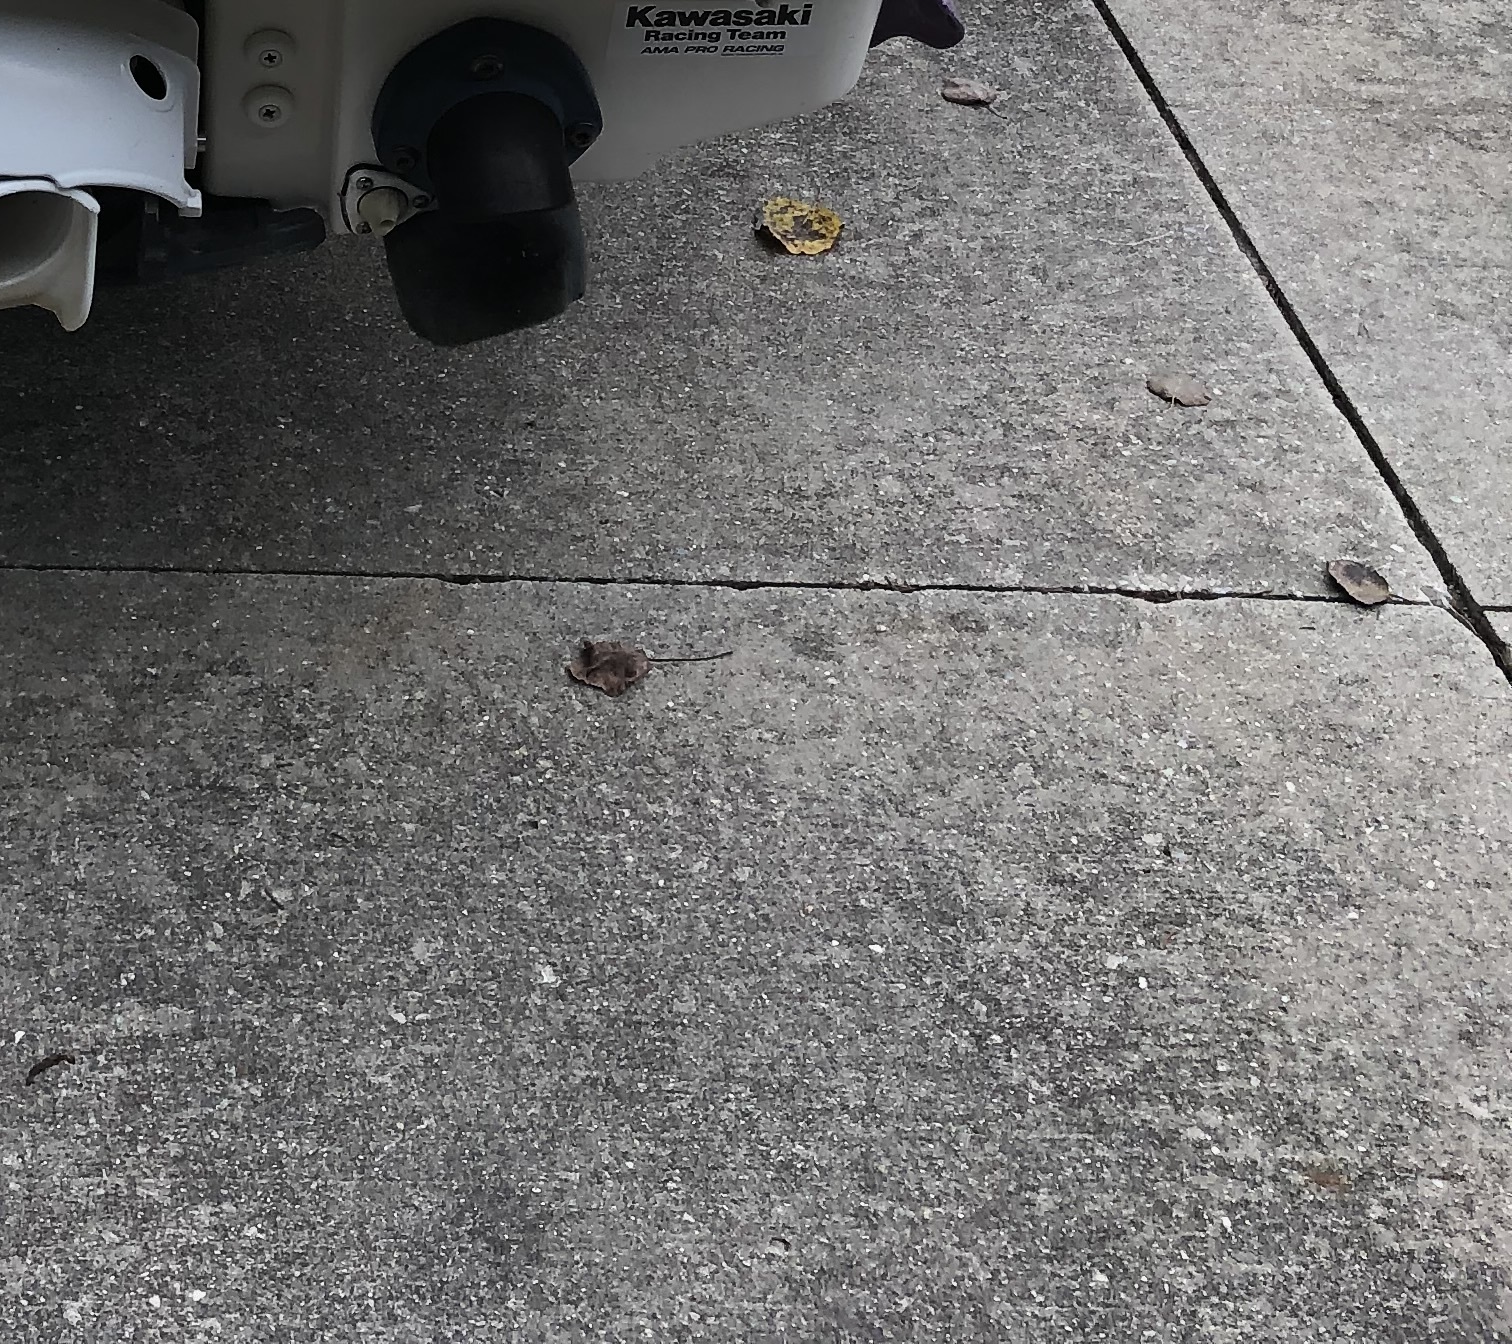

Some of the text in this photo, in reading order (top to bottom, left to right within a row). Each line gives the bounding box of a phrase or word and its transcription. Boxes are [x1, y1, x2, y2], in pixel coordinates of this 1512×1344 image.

[625, 3, 813, 28] Kawasaki
[644, 28, 786, 43] Racing Team
[640, 44, 785, 54] AMA PRO RACING
